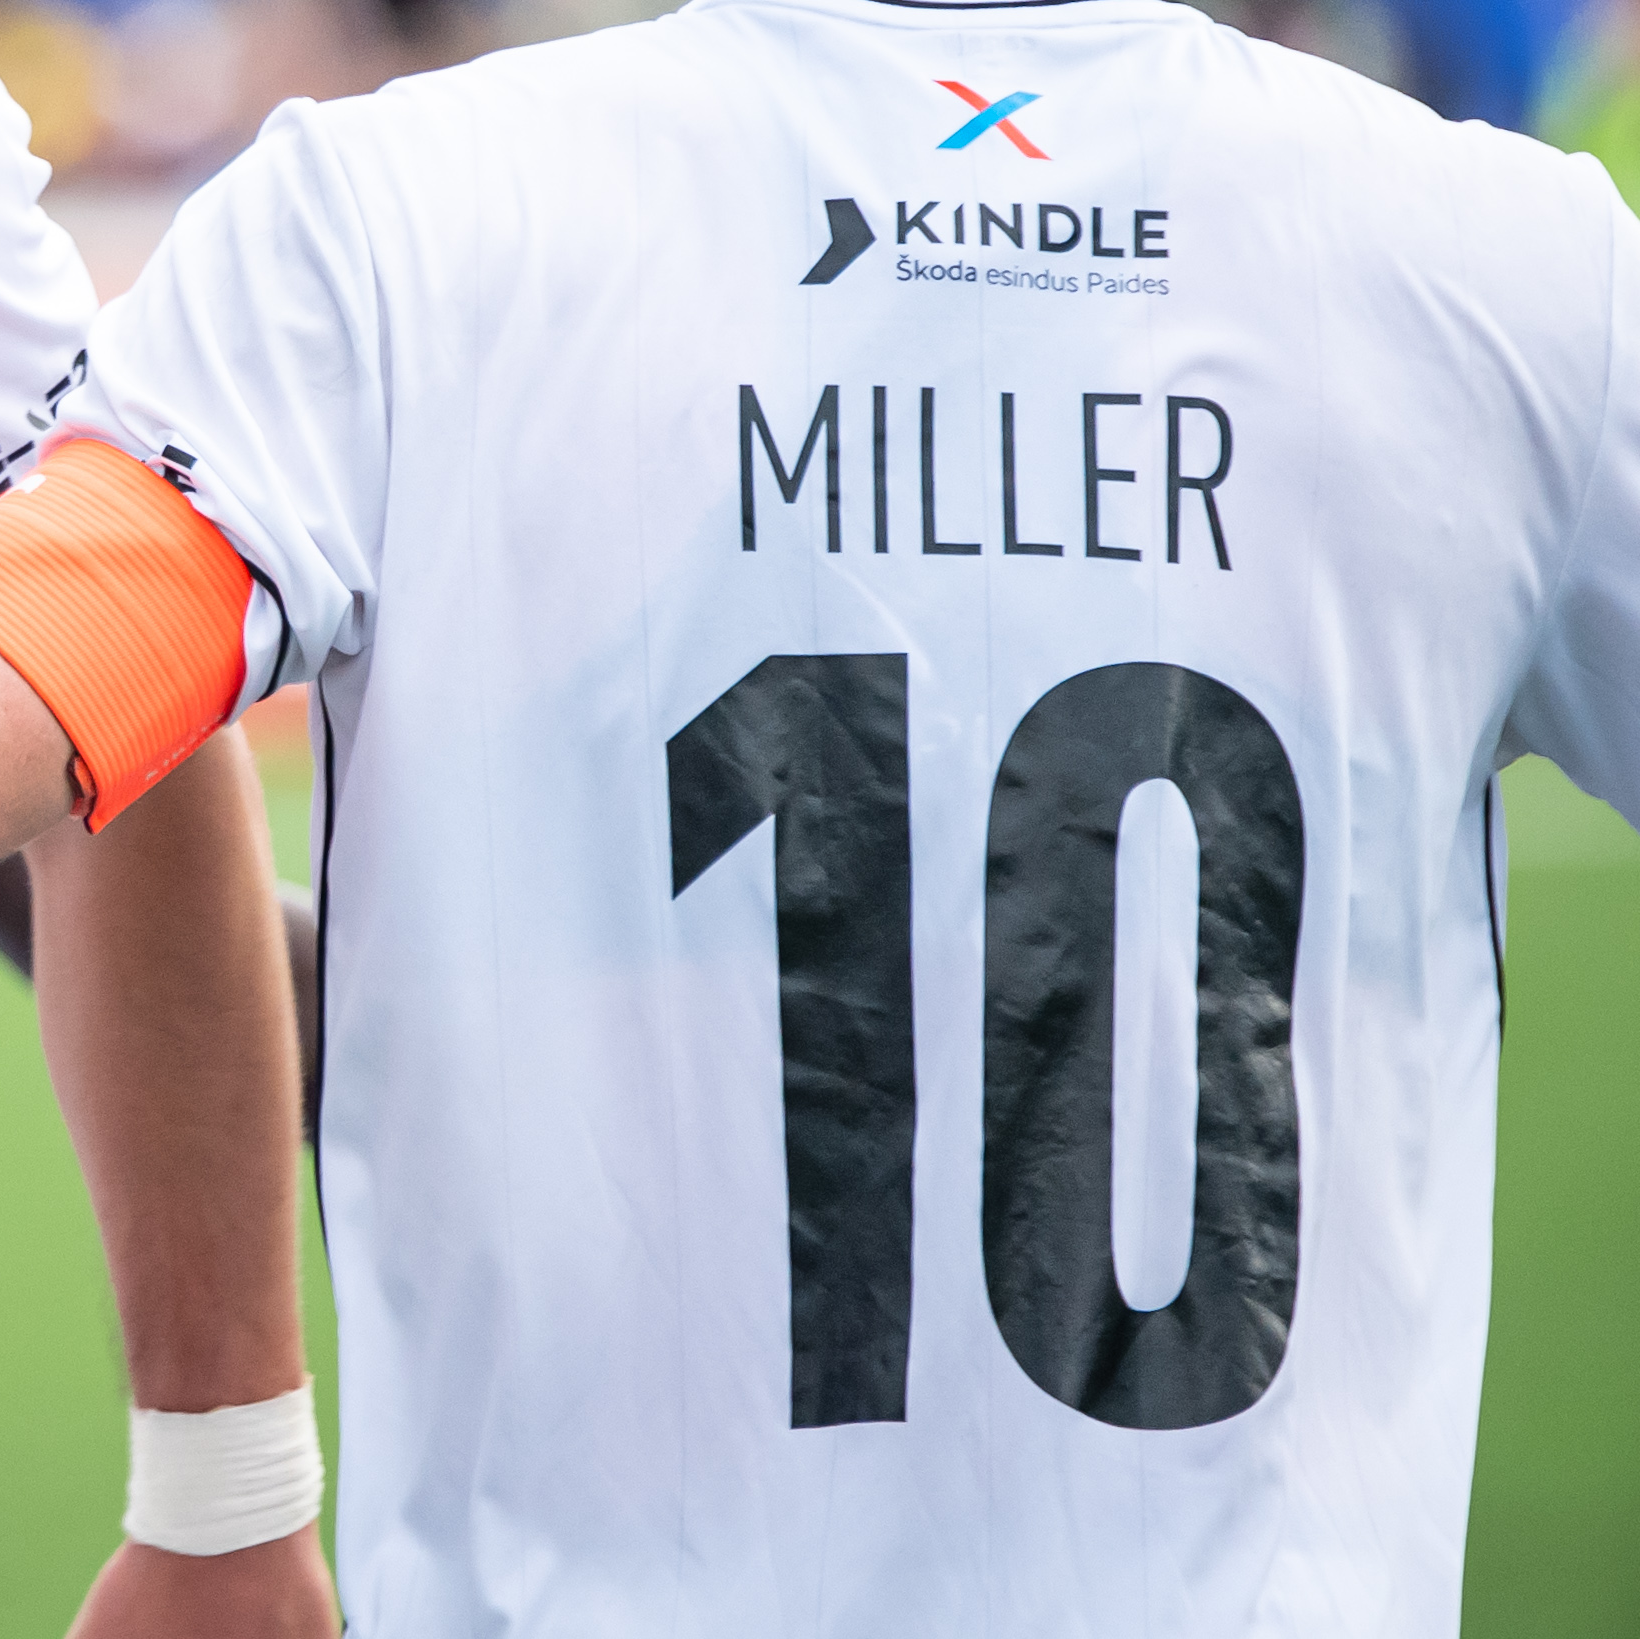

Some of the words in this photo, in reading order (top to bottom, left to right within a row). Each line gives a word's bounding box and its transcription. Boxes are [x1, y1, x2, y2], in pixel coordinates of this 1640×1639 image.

[895, 253, 979, 283] Škoda
[985, 265, 1079, 294] esindus
[1087, 271, 1171, 296] Paides
[896, 200, 1170, 259] KINDLE
[738, 383, 1234, 572] MILLER
[665, 652, 1307, 1431] 10
